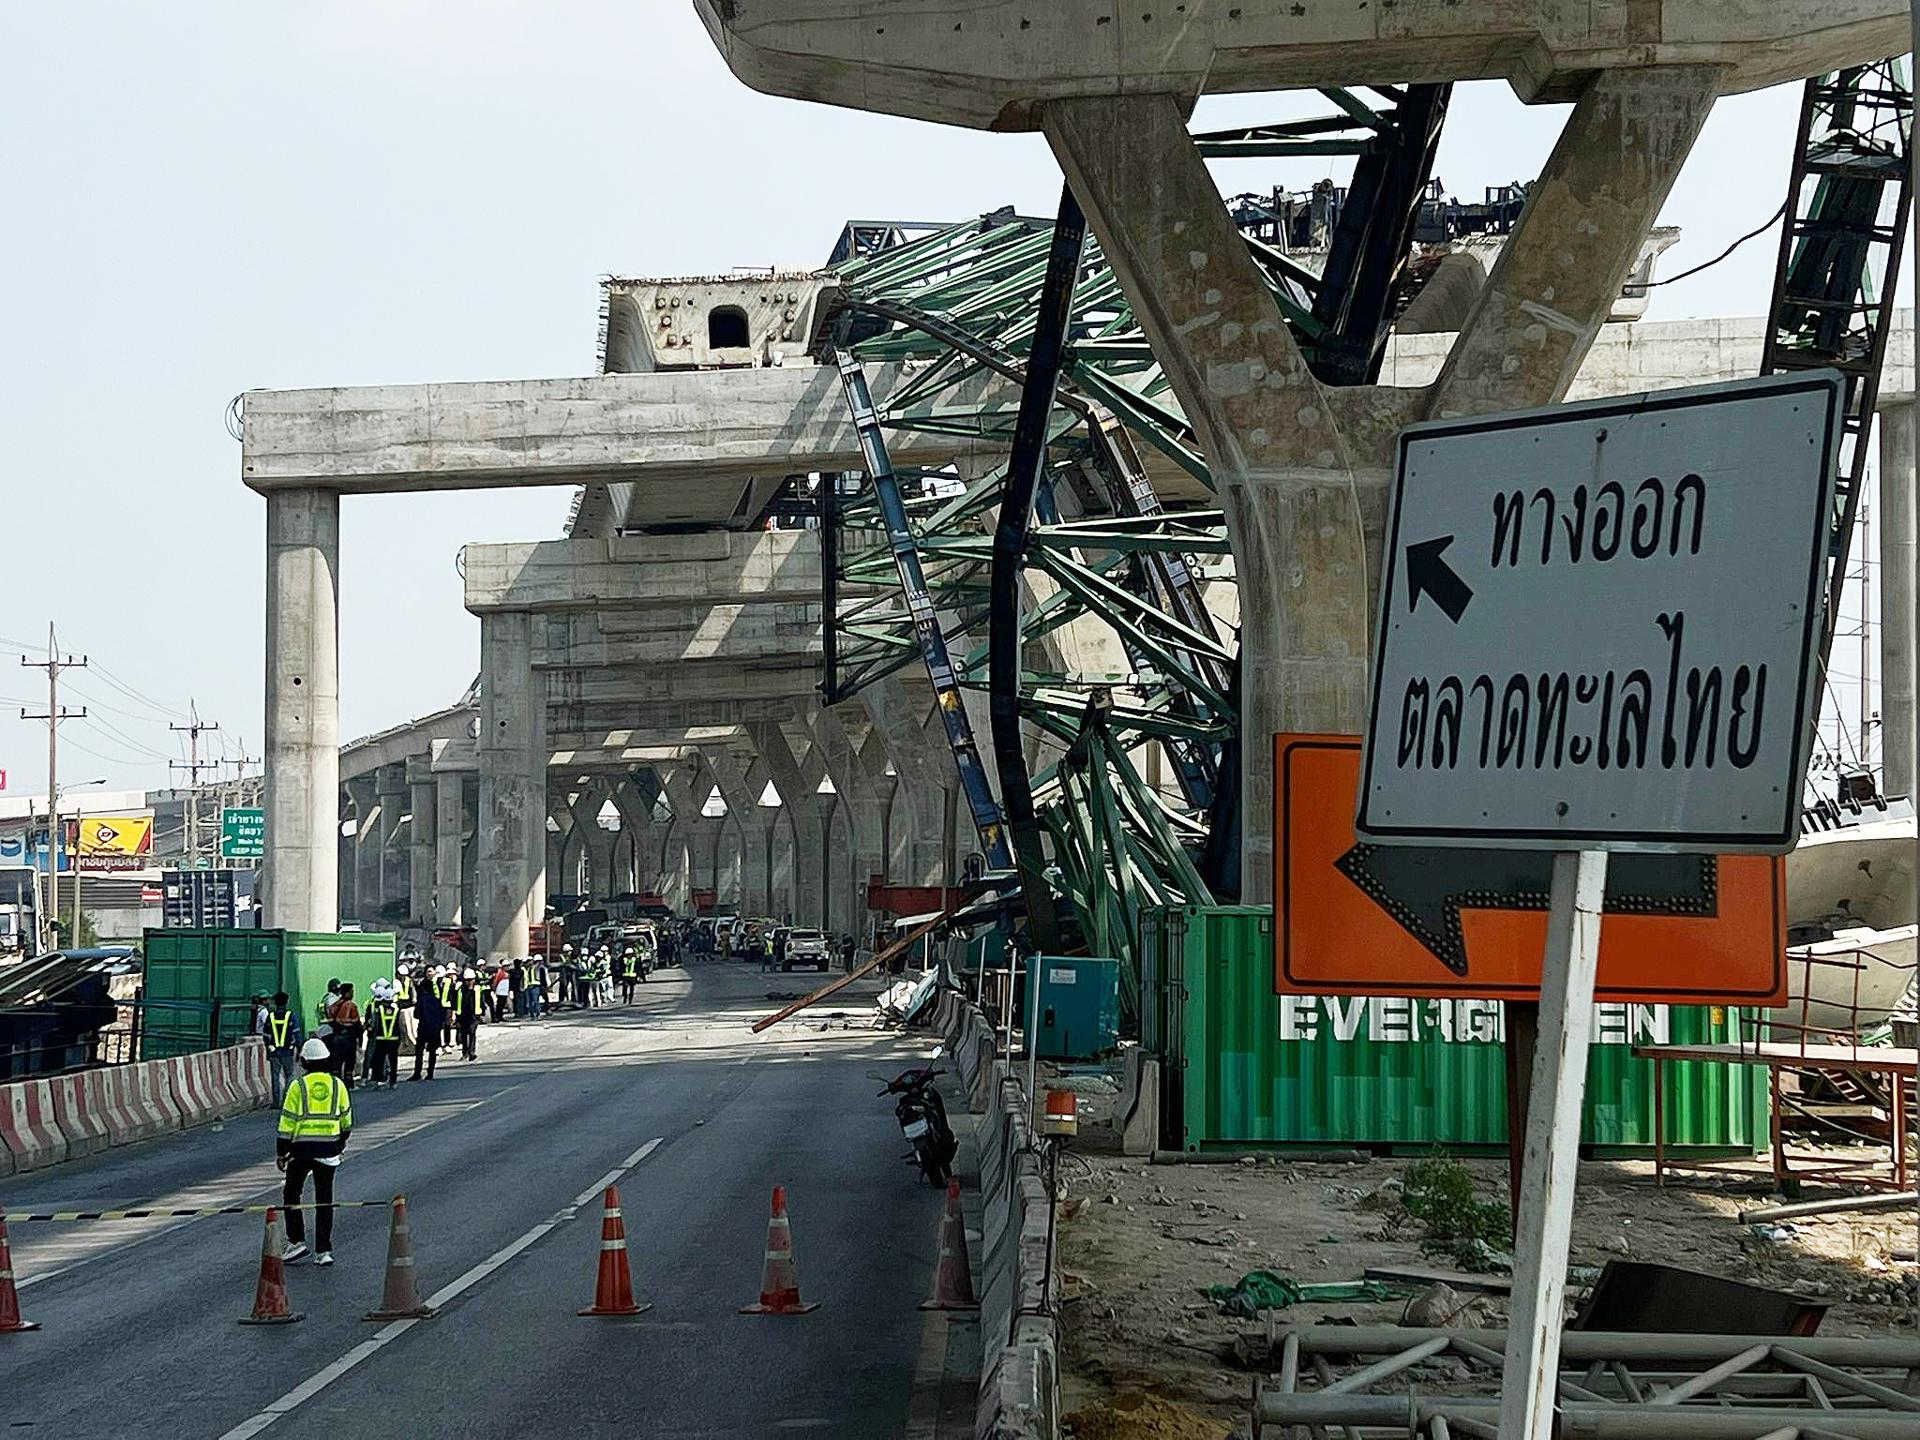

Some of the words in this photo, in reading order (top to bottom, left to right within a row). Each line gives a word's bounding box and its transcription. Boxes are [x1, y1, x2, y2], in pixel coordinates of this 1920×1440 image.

[1491, 473, 1706, 568] ทางออก
[1397, 611, 1768, 770] ตลาดทะเลไทย
[1280, 995, 1670, 1044] EVERGEN
